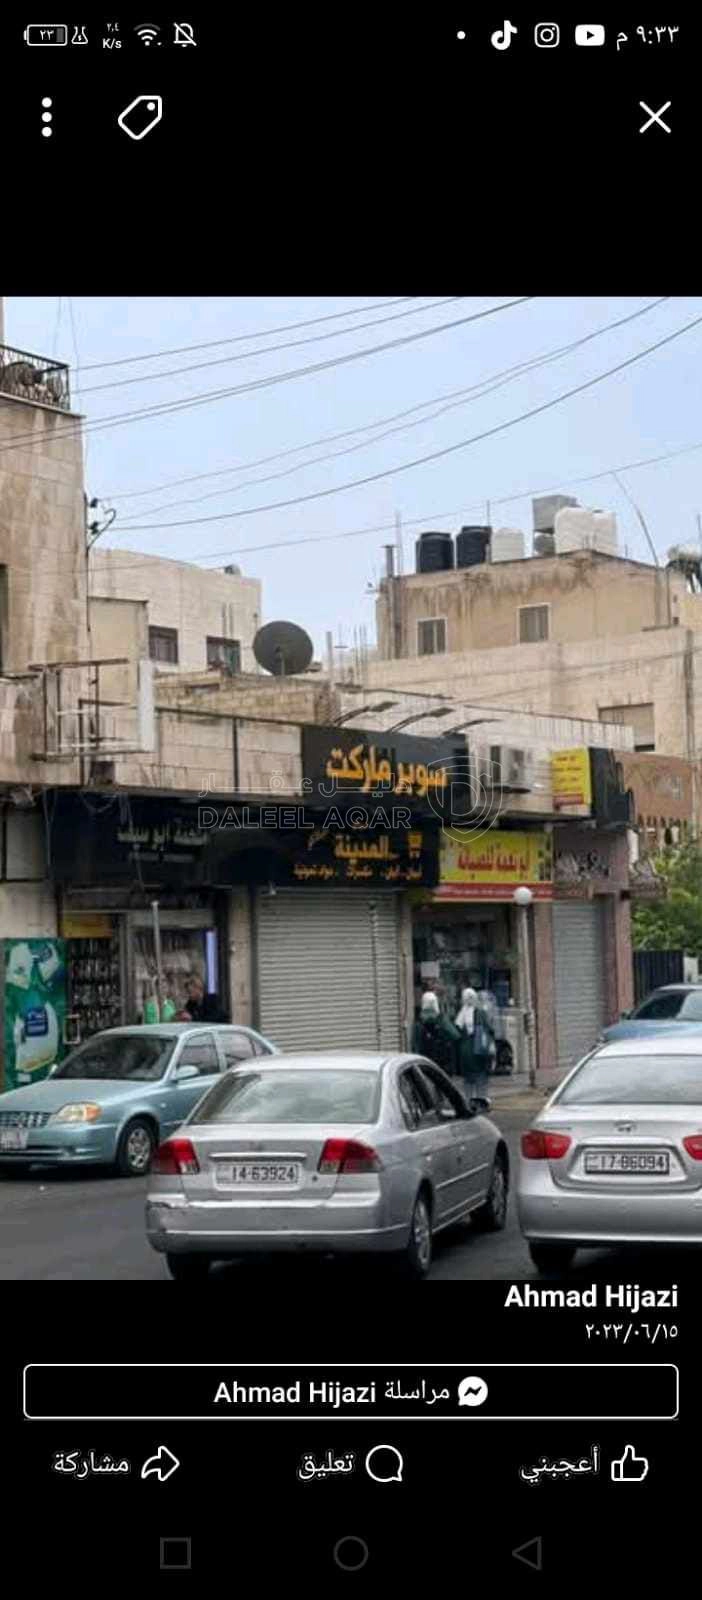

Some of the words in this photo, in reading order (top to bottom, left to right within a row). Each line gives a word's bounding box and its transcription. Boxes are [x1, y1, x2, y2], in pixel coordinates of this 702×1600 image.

[326, 744, 391, 794] ماركت
[394, 763, 448, 796] سوبر
[334, 834, 390, 865] المدينة
